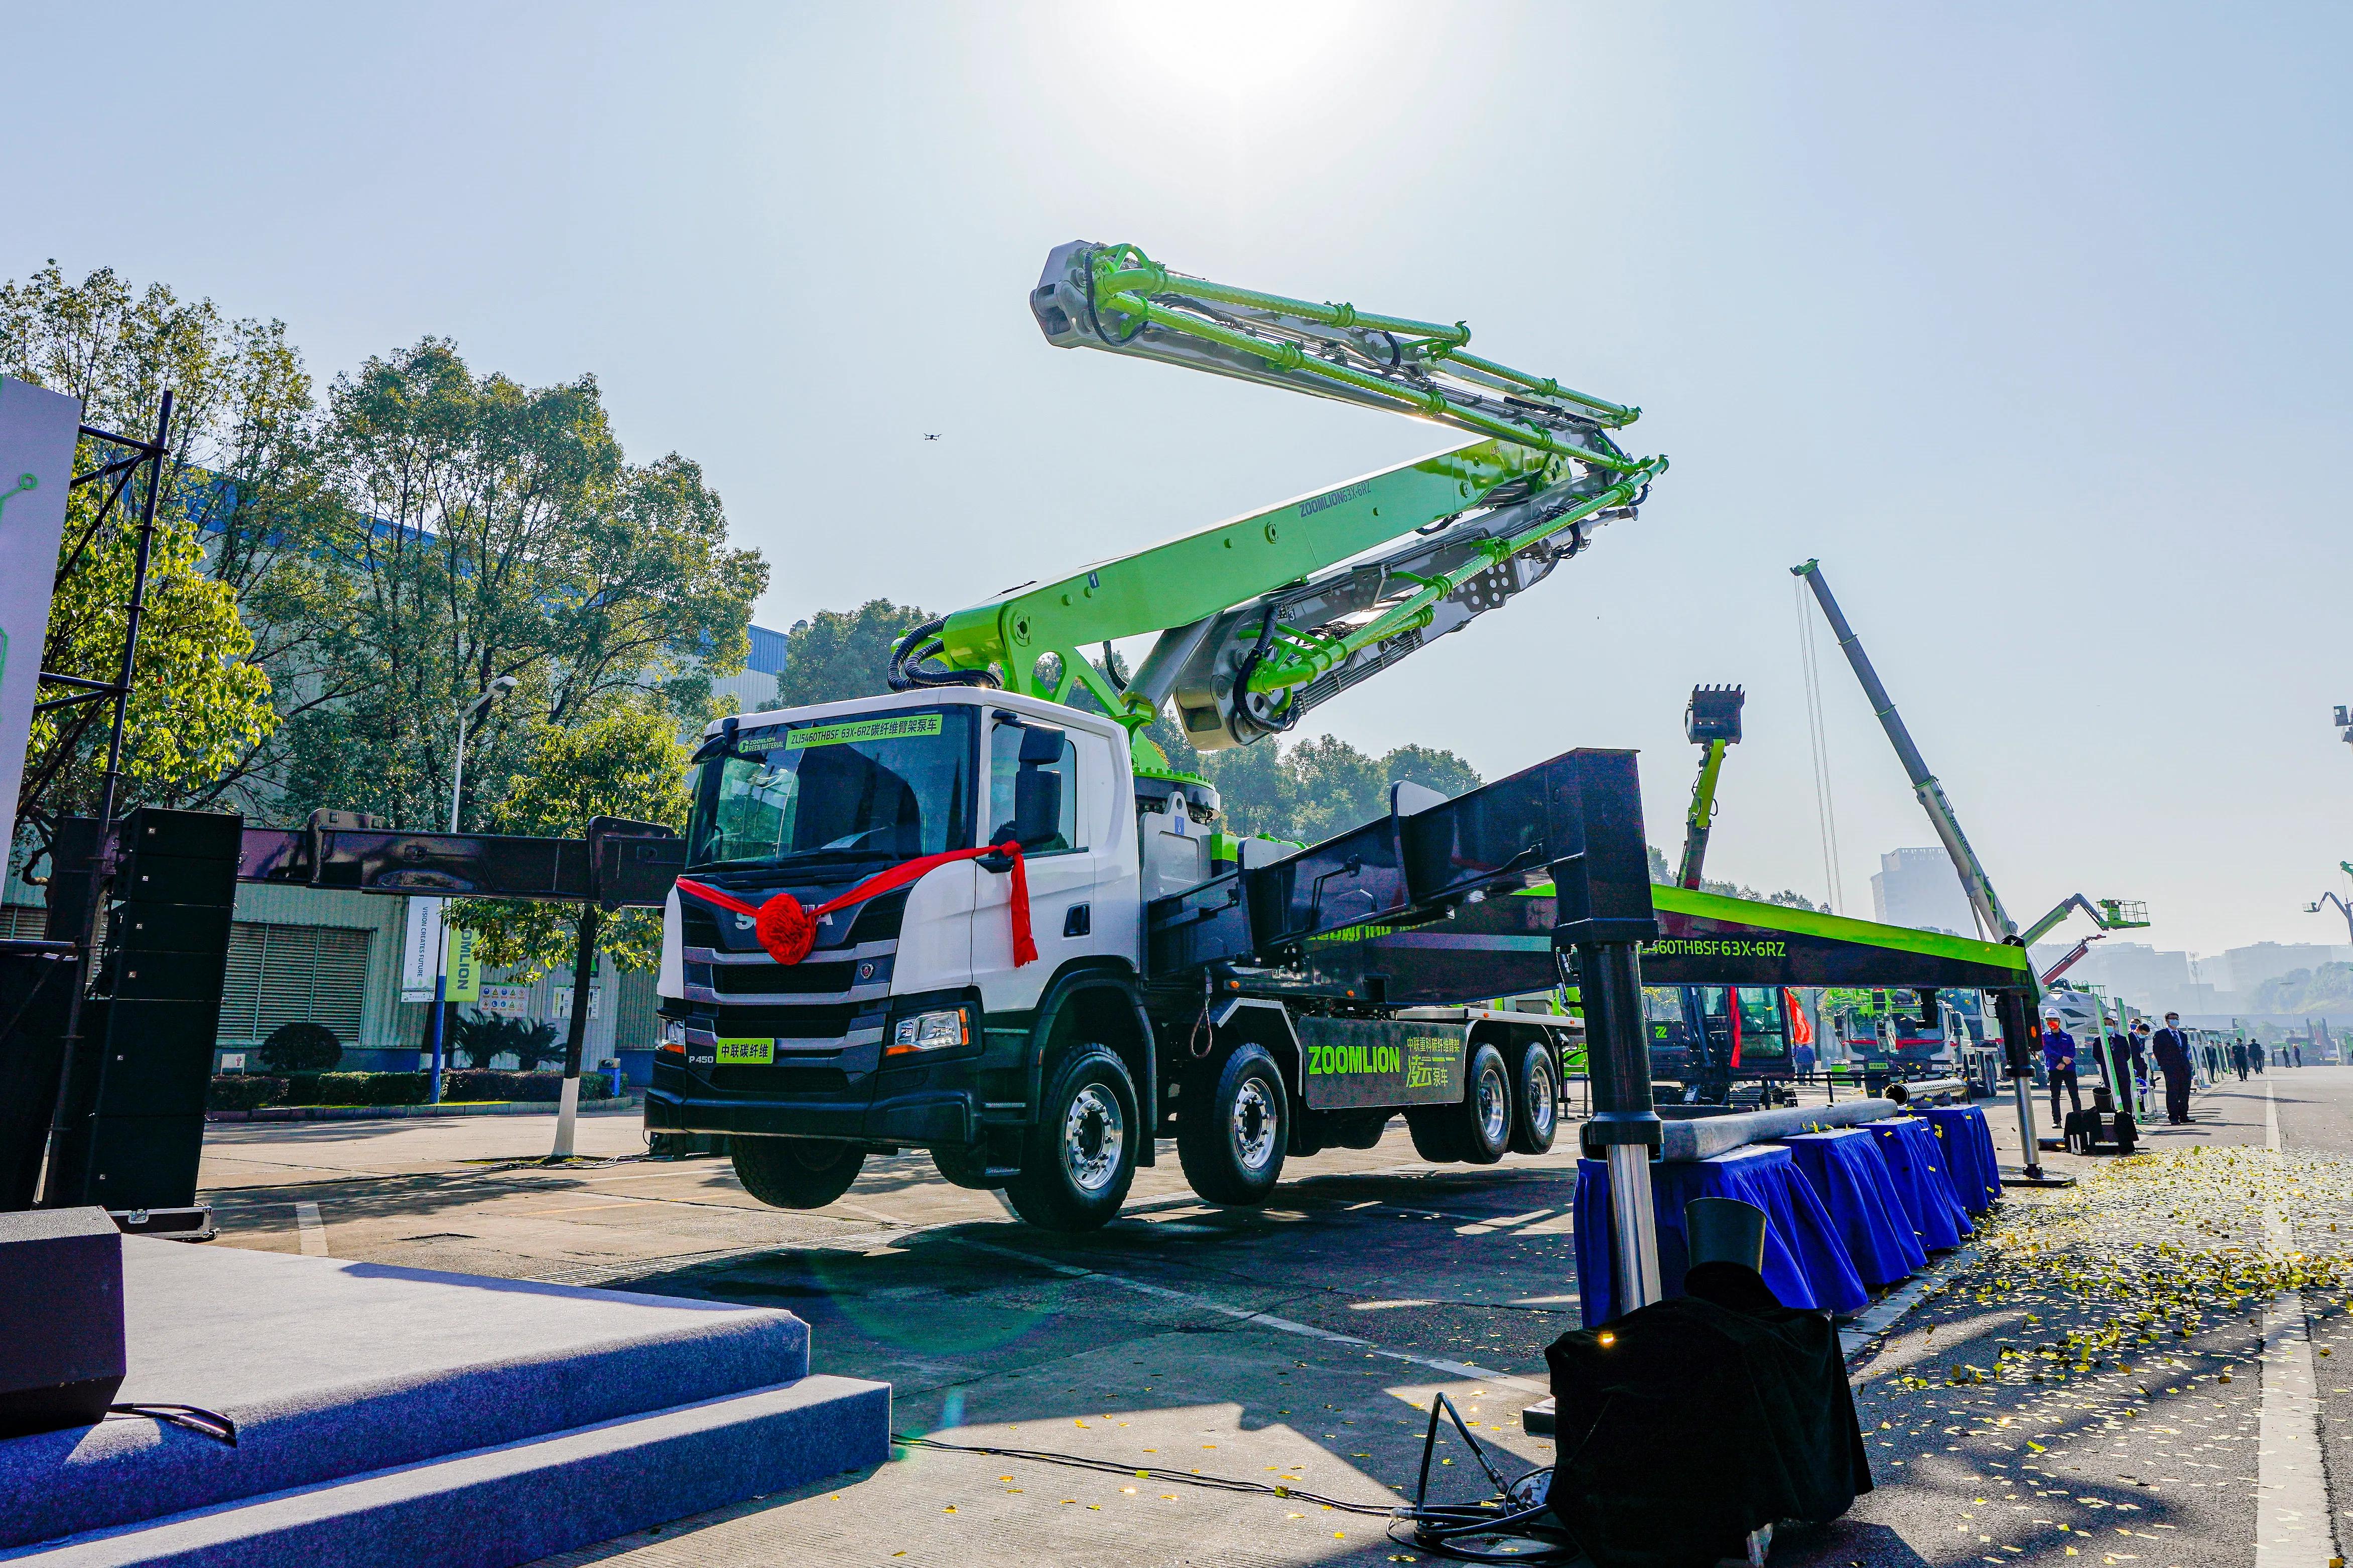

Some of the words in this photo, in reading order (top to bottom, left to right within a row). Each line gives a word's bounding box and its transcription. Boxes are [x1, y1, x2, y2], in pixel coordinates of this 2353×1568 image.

[1091, 574, 1097, 587] 1
[1288, 610, 1295, 621] 3
[749, 737, 775, 745] ZOOMLION
[791, 729, 840, 745] ZLJ5460THBSF
[761, 741, 784, 750] MATERIAL
[1949, 815, 1972, 854] ZOOMLION
[1638, 940, 1719, 955] 60THBSF
[1721, 941, 1786, 957] 63X-6RZ
[457, 928, 473, 990] OMLION
[721, 1043, 769, 1058] 中联碳纤维
[1407, 1036, 1460, 1053] 中联重科碳纤维臂架
[1308, 1046, 1400, 1075] ZOOMLION
